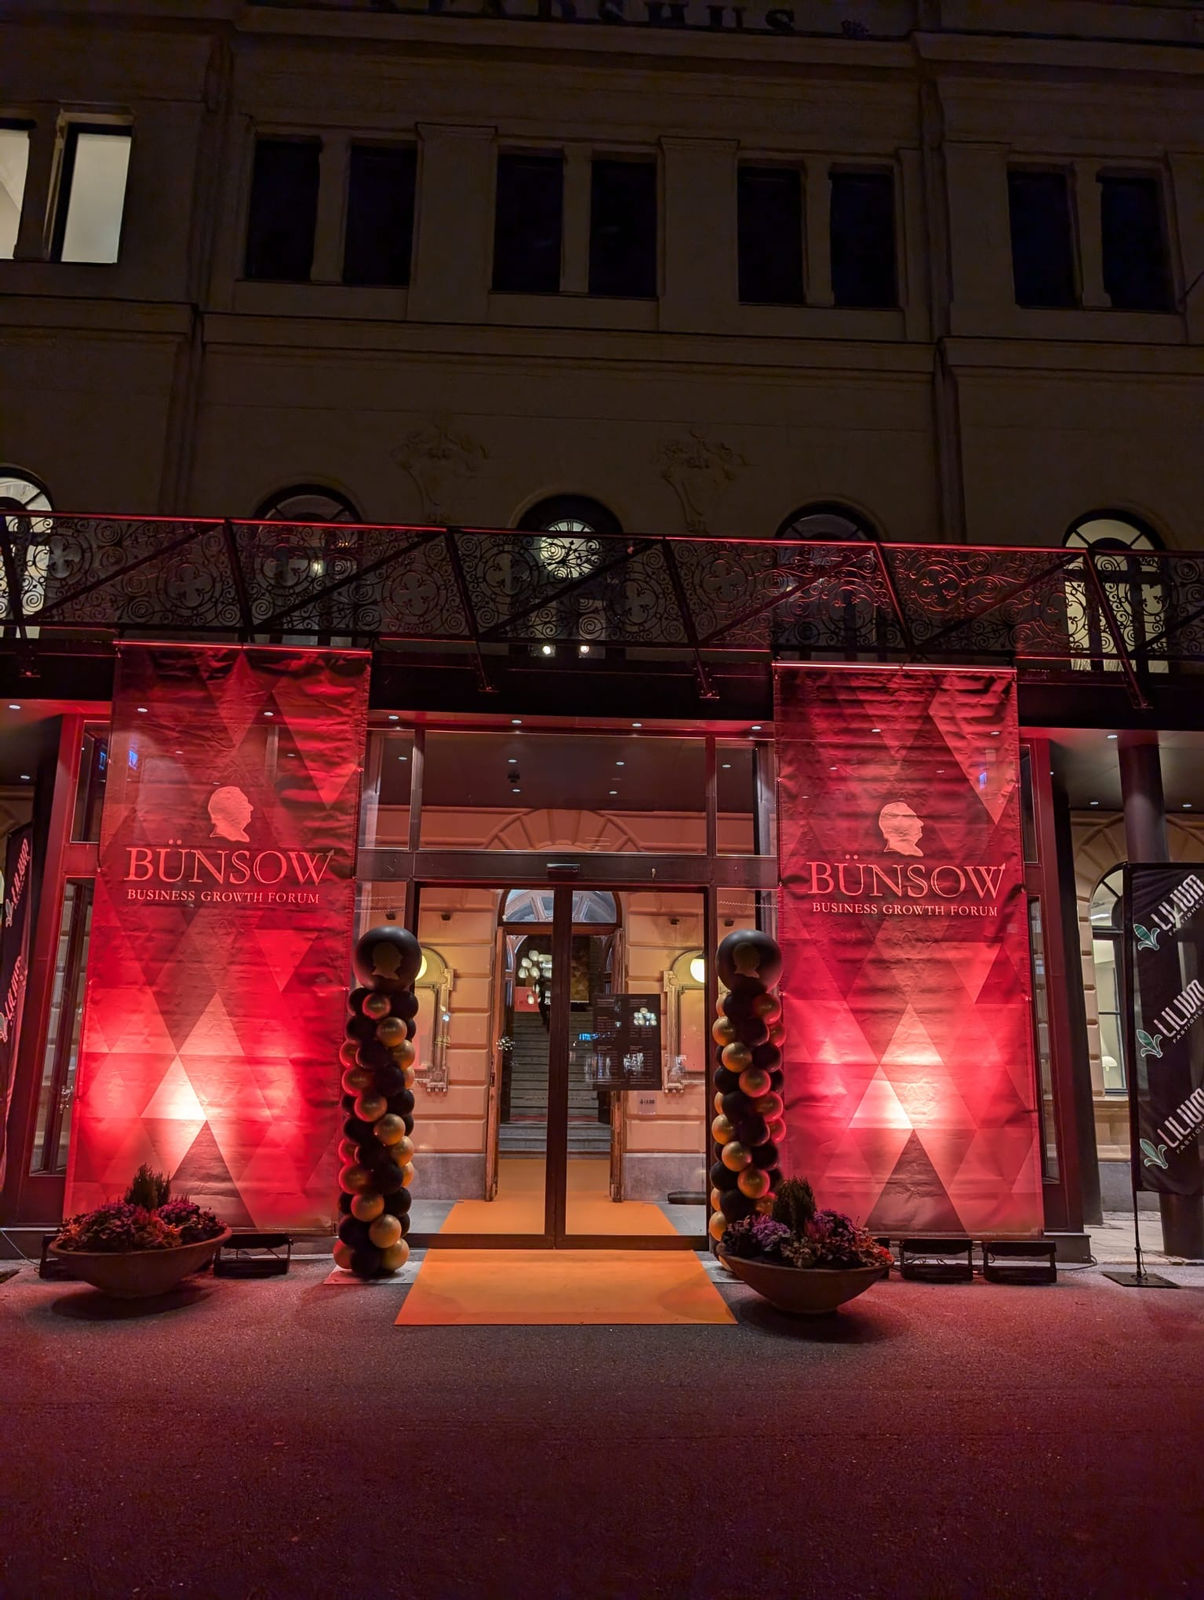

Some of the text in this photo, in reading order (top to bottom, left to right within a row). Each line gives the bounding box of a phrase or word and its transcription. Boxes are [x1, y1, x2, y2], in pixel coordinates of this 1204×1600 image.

[124, 839, 335, 886] BÜNSOW
[806, 854, 1006, 899] BÜNSOW
[127, 889, 320, 904] BUSINESS GROWTH FORUM
[812, 902, 998, 917] BUSINESS GROWTH FORUM
